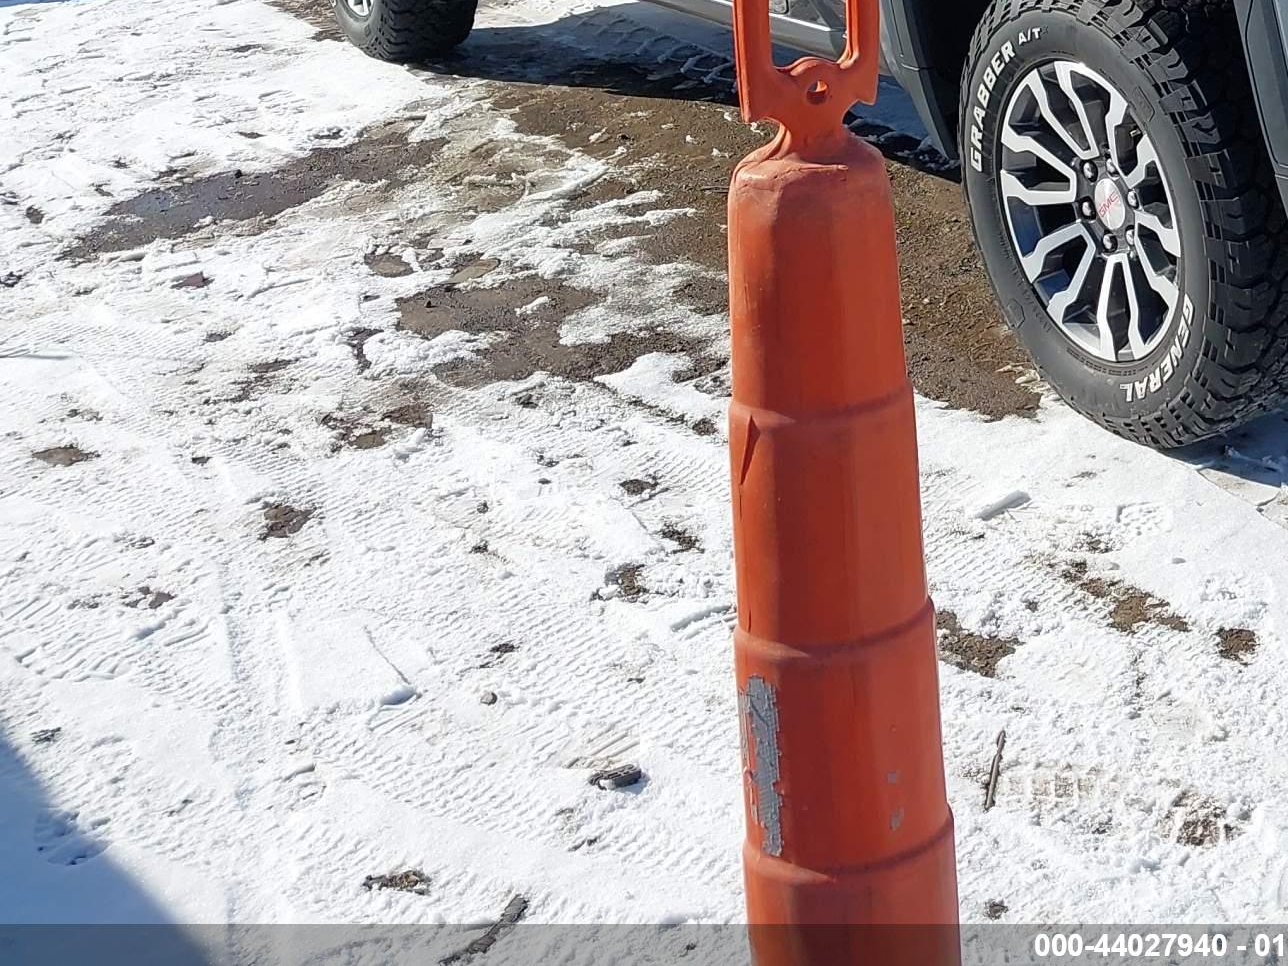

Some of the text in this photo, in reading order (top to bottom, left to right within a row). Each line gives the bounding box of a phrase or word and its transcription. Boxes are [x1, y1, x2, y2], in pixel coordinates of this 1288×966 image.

[970, 40, 1016, 172] GRABBER
[1098, 190, 1119, 218] GMC
[1119, 293, 1194, 402] GENERAL
